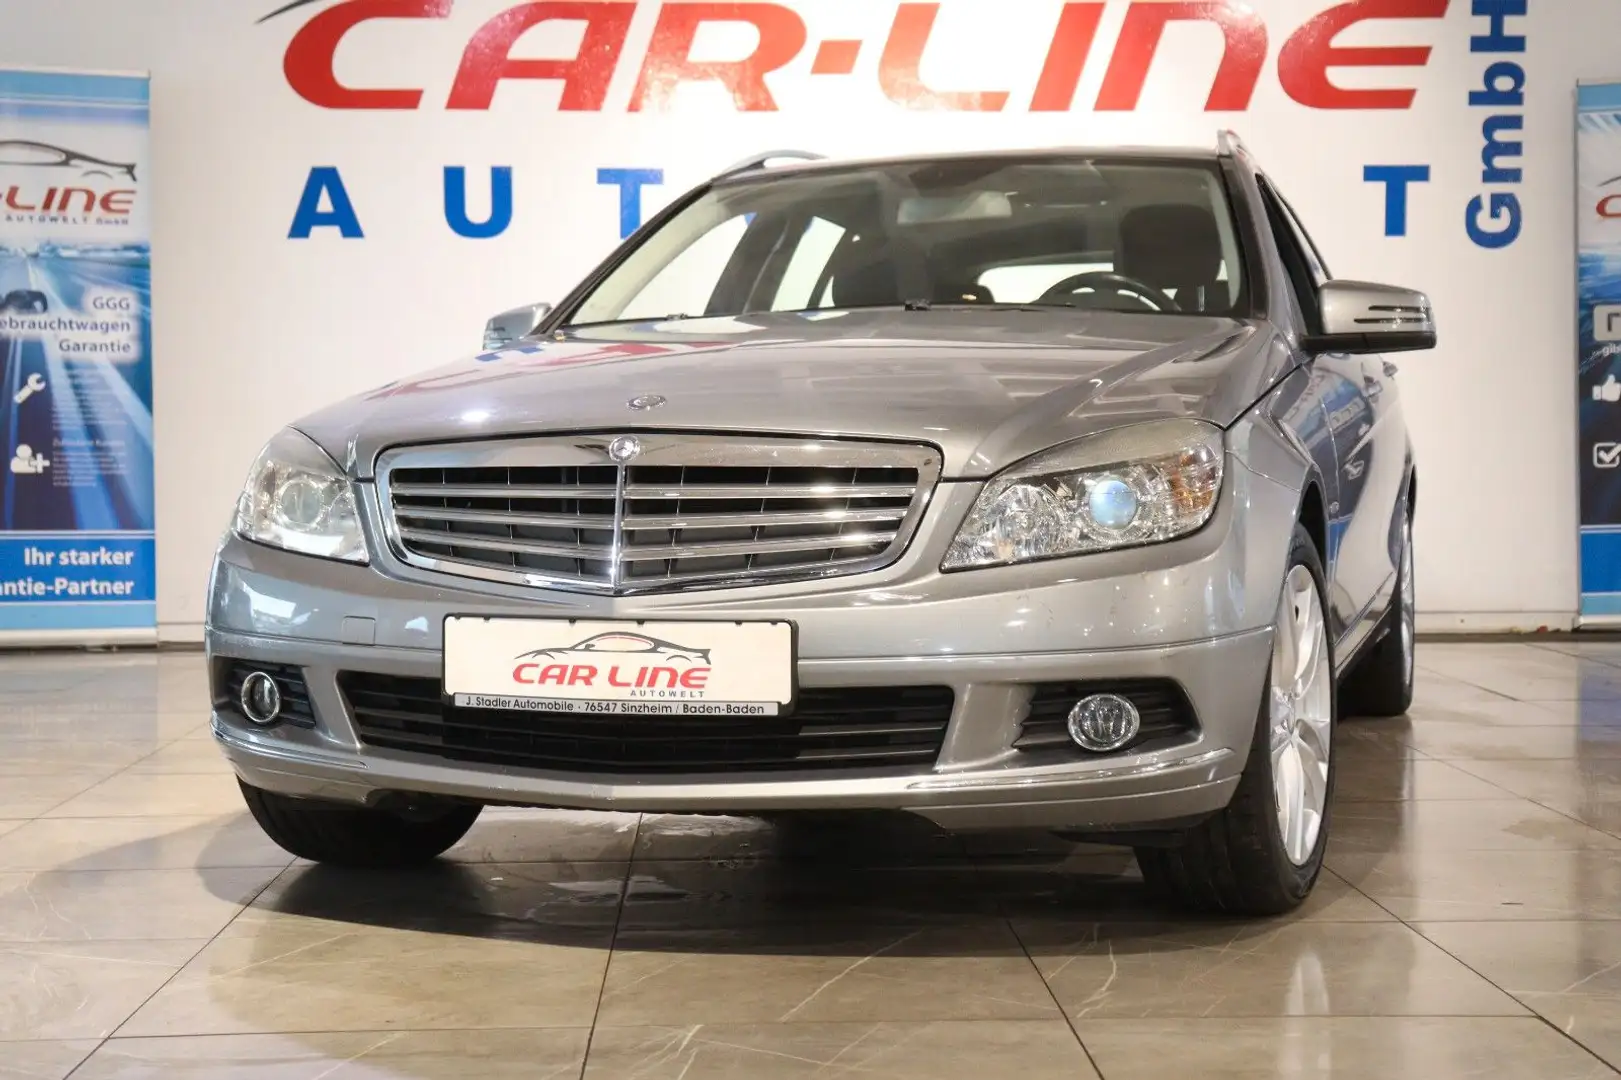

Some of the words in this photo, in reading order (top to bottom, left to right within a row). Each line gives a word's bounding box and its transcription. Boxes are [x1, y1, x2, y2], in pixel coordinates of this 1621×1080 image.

[283, 0, 1449, 111] CAR-LINE
[1467, 0, 1526, 248] GmbH
[5, 214, 88, 224] AUTOWELT
[96, 217, 129, 225] GmbH
[92, 296, 130, 310] GGG
[58, 338, 131, 352] Garantie
[24, 547, 55, 565] Ihr
[59, 547, 134, 565] starker
[0, 577, 134, 596] ntie-Partner
[512, 663, 598, 685] CAR
[608, 666, 711, 689] LINE
[630, 690, 705, 698] AUTOWELT
[465, 697, 475, 706] J.
[476, 697, 511, 708] Stadler
[513, 699, 574, 711] Automobile
[584, 702, 618, 713] 76547
[621, 703, 672, 714] Sinzheim
[683, 704, 765, 715] Baden-Baden
